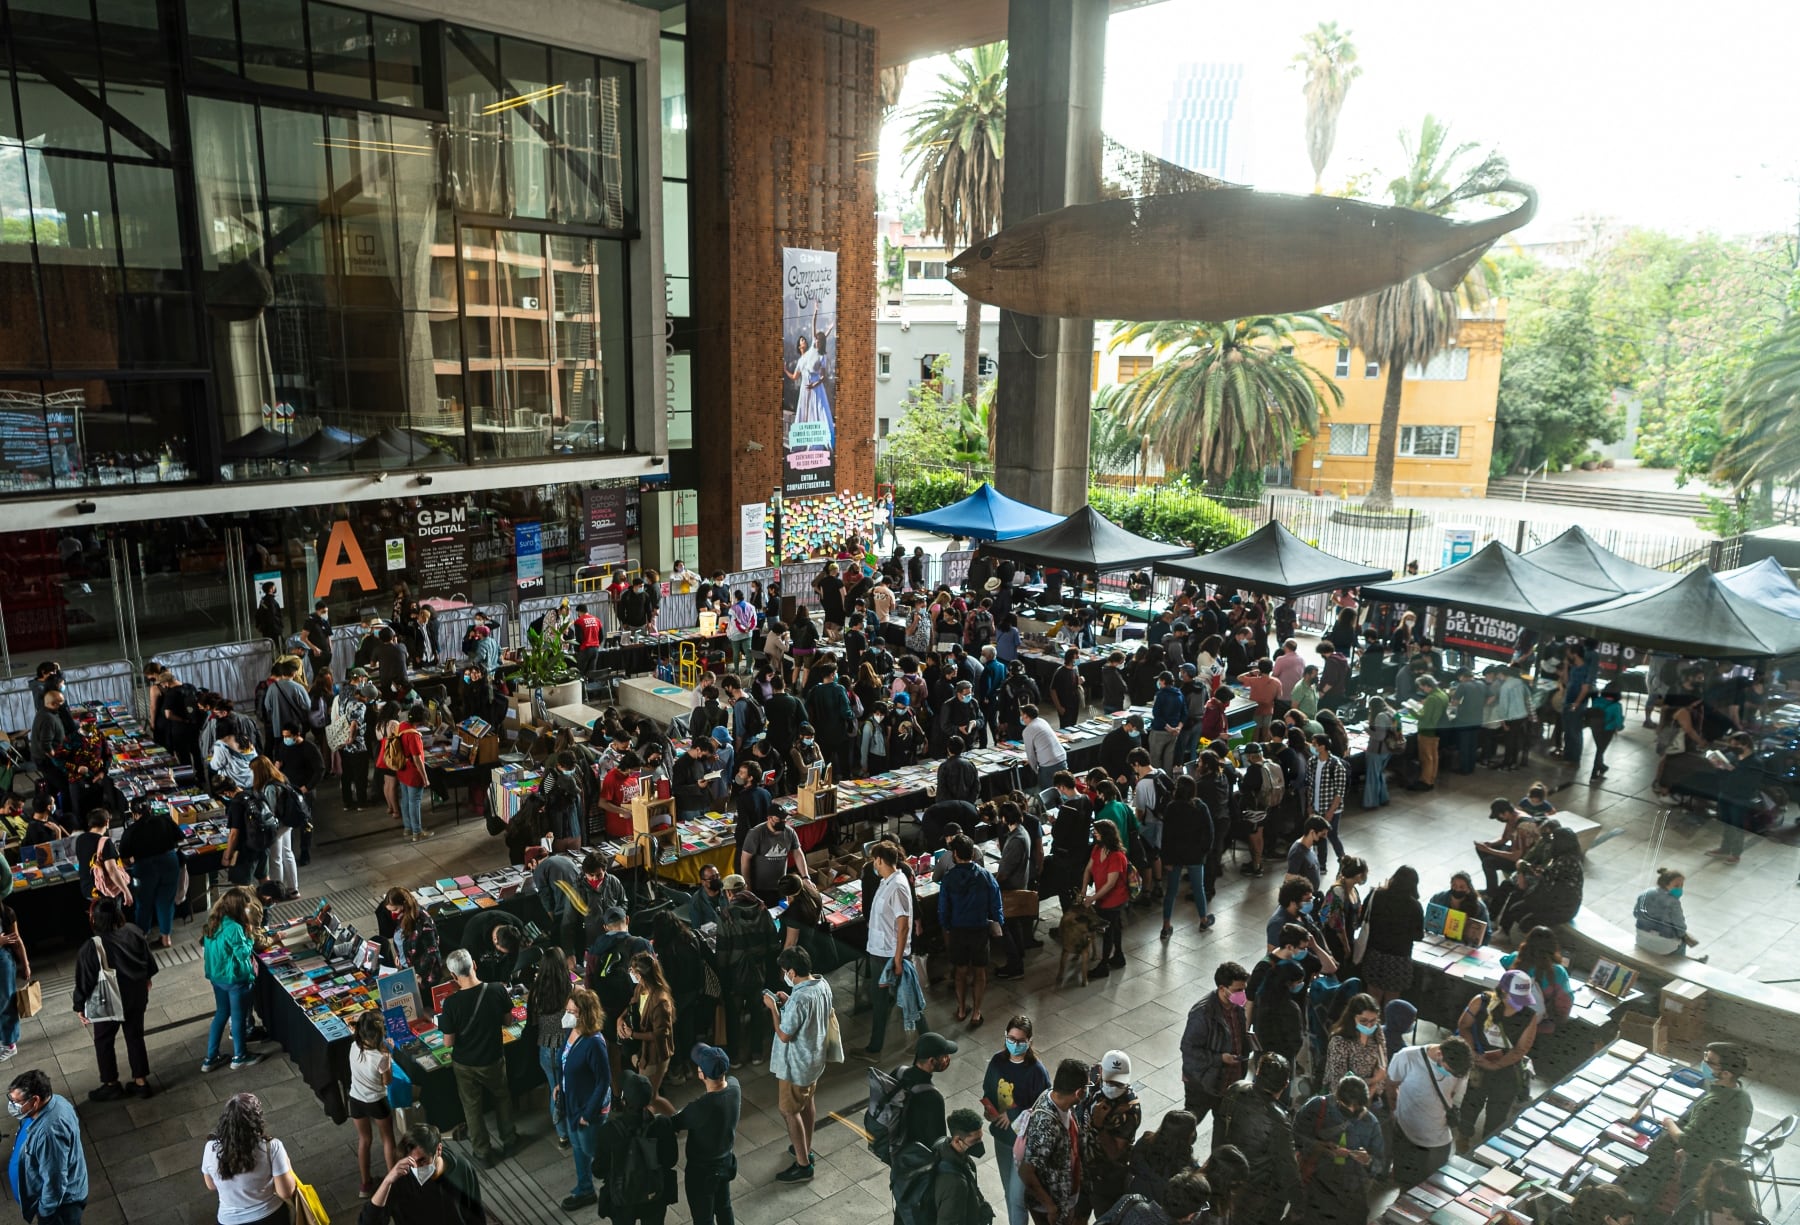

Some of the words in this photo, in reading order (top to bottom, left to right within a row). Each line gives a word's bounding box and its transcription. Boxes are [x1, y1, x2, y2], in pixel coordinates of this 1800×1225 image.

[788, 265, 832, 287] Comparte
[799, 284, 831, 309] Sentir
[417, 507, 465, 526] GAM
[418, 524, 466, 537] DIGITAL
[313, 520, 378, 599] A
[520, 577, 544, 589] GAM
[1445, 620, 1472, 633] DEL
[1474, 625, 1517, 643] LIBRO
